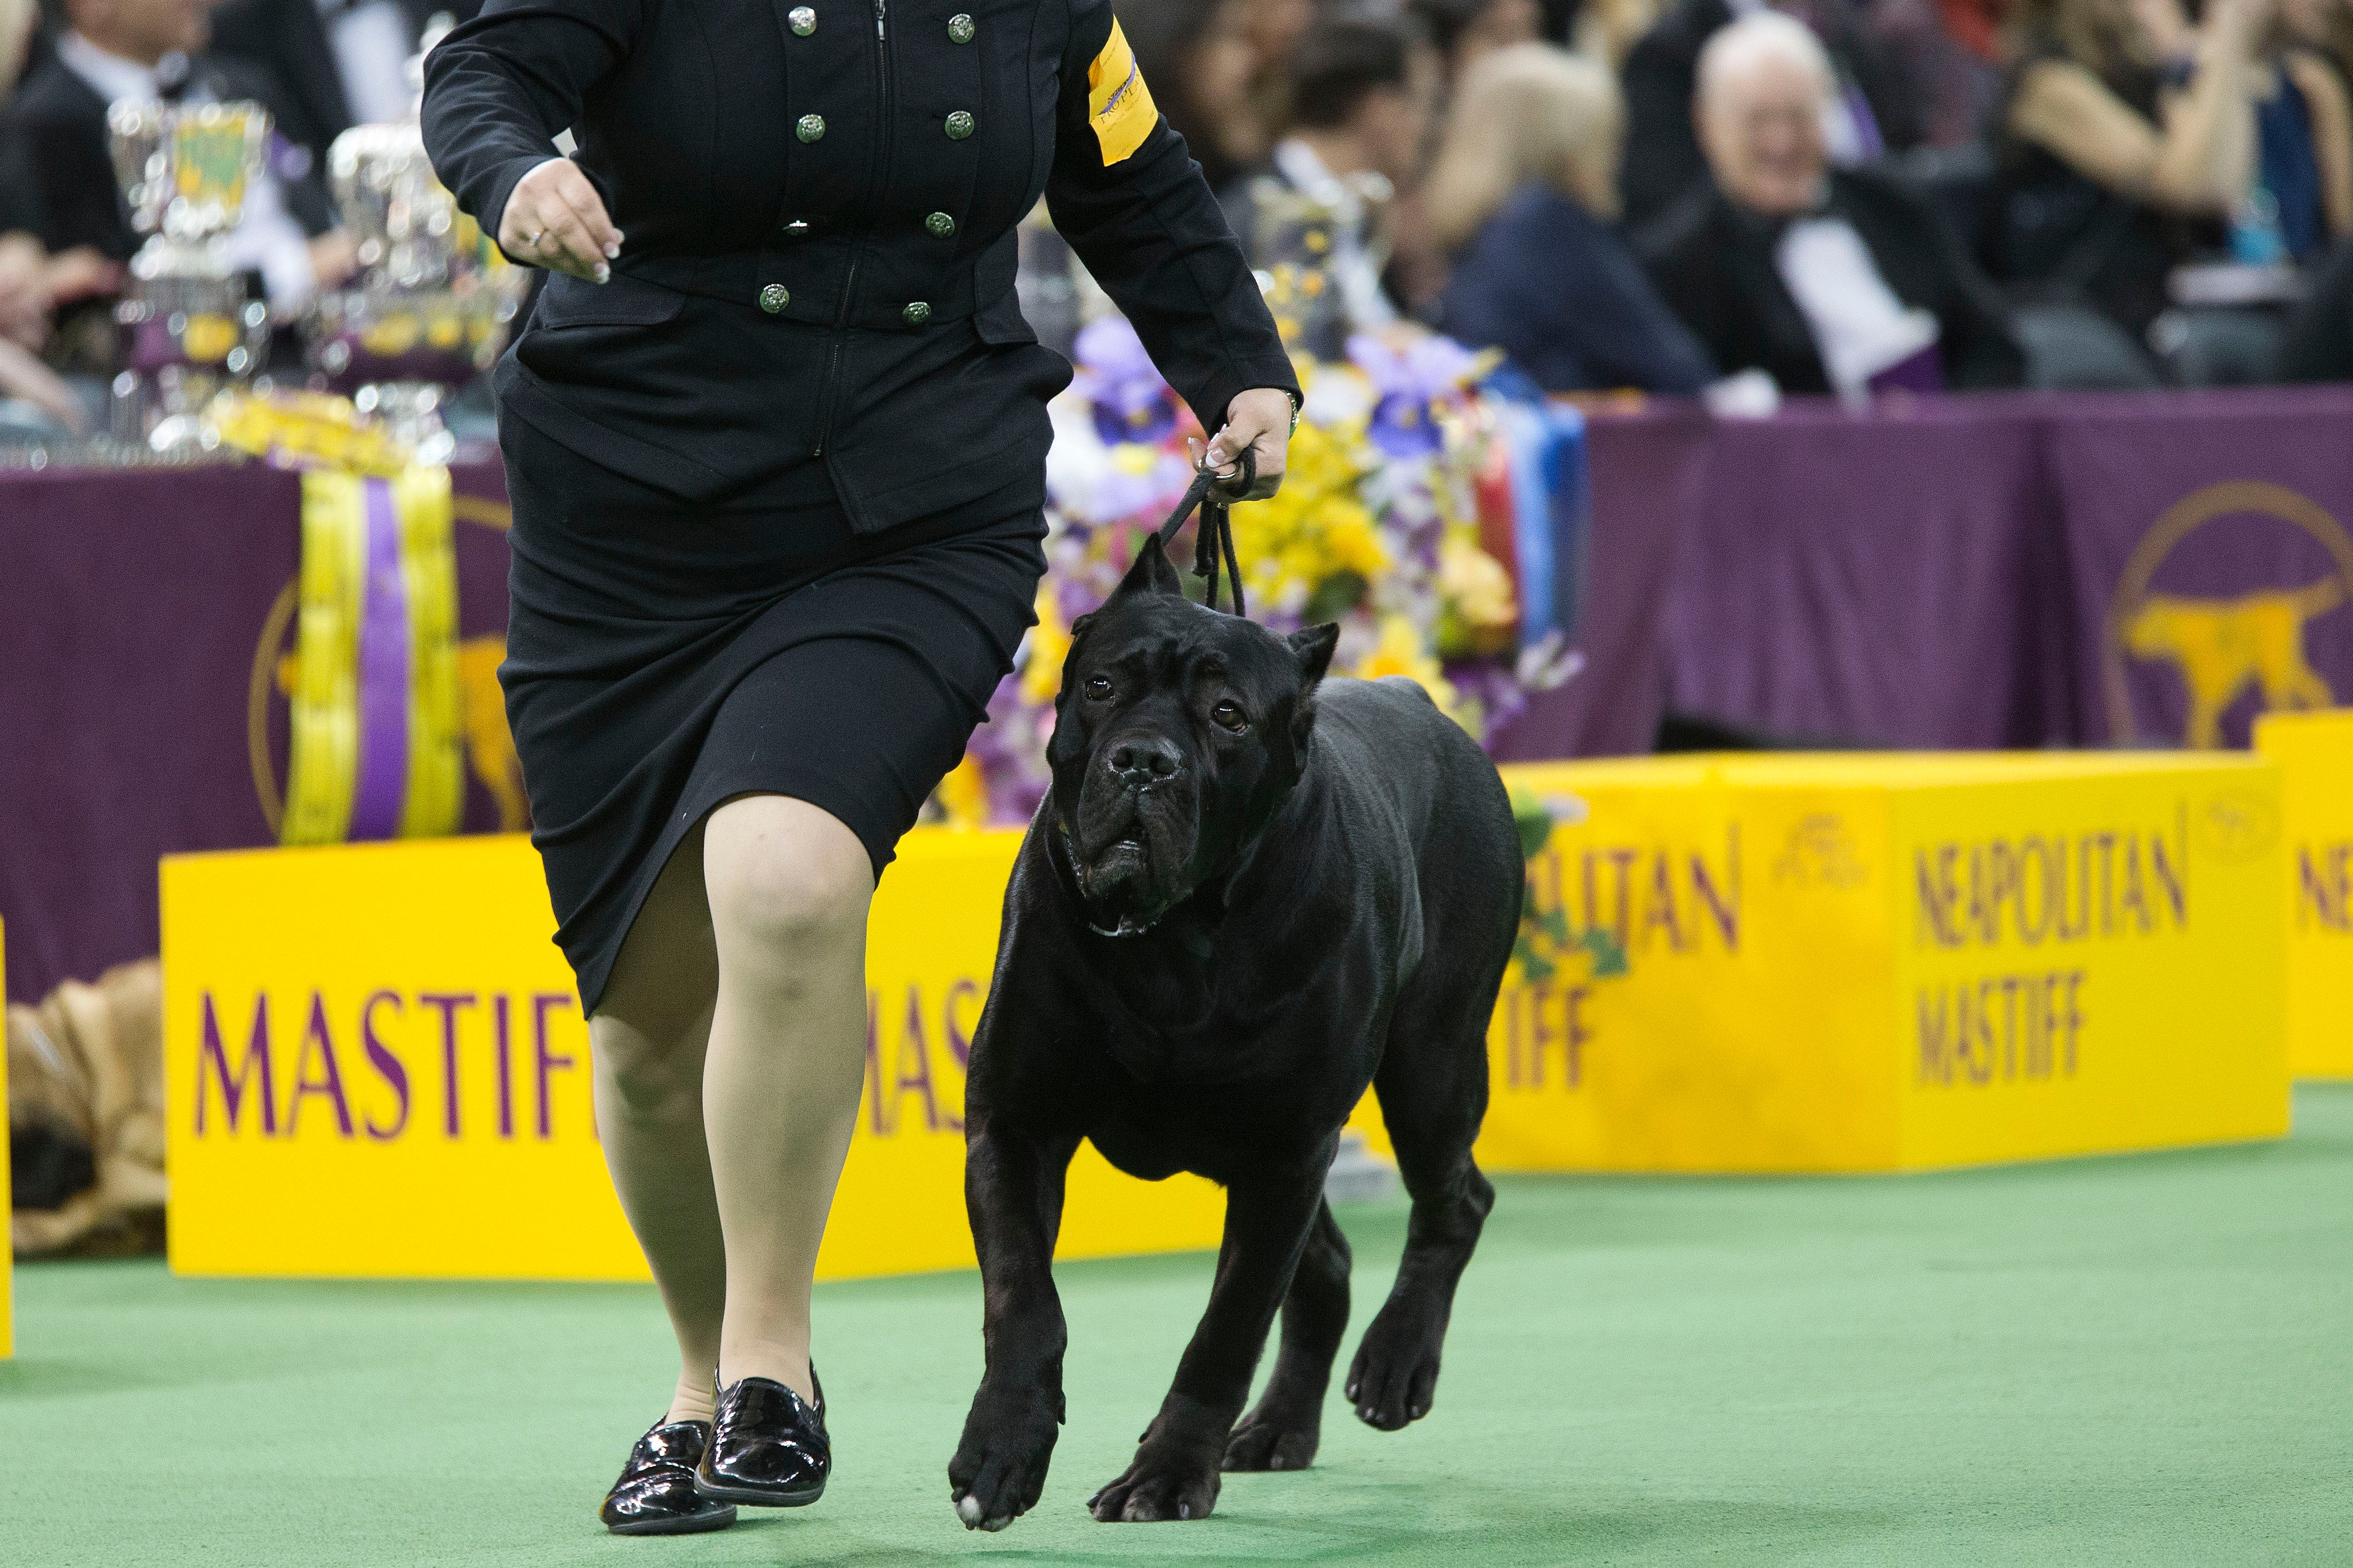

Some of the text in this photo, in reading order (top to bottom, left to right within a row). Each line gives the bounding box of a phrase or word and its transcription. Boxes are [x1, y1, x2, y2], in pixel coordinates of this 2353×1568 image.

[1915, 803, 2188, 948] NEAPOLITAN
[191, 989, 598, 1142] MASTIF
[1915, 970, 2085, 1088] MASTIFF
